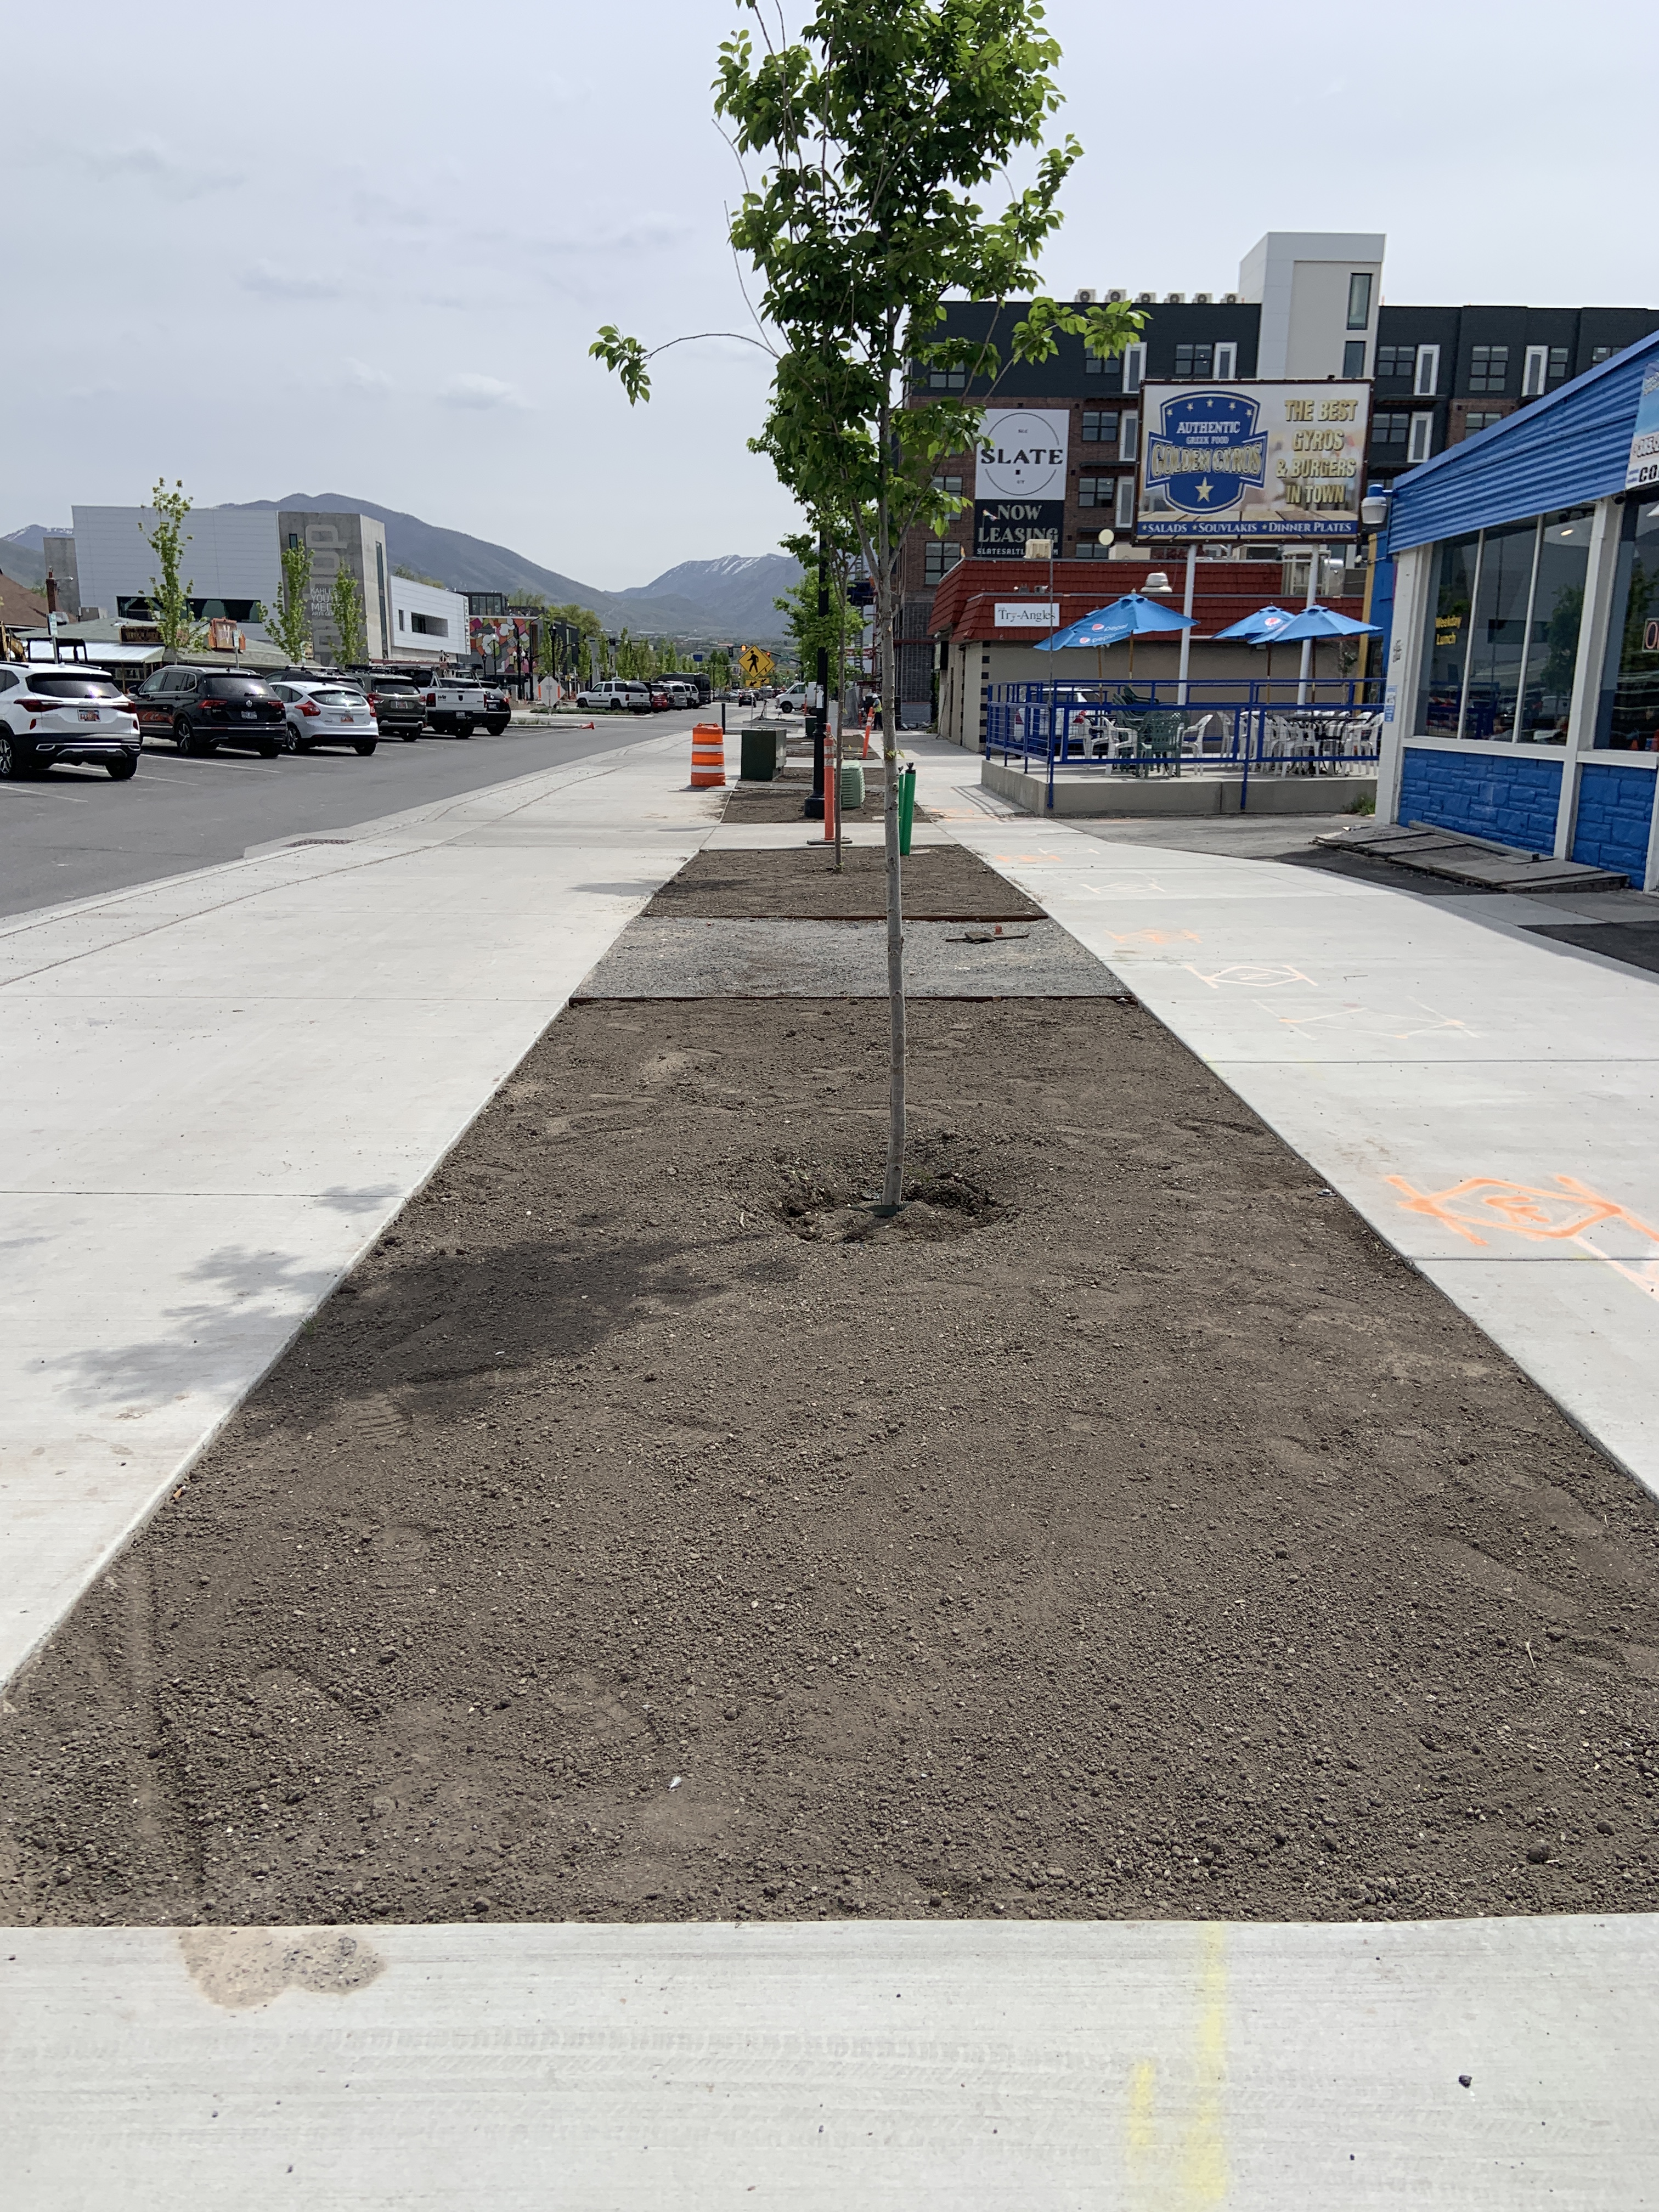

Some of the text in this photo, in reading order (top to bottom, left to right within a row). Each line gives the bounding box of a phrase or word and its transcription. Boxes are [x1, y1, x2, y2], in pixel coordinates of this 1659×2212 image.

[1284, 399, 1358, 421] THE BEST
[1176, 421, 1240, 433] AUTHENTIC
[1293, 429, 1344, 451] GYROS
[981, 448, 1063, 465] SLATE
[1151, 442, 1262, 478] GOLDEN GYROS
[1276, 458, 1357, 478] & BURGERS
[1285, 484, 1345, 504] IN TOWN
[997, 505, 1042, 521] NOW
[978, 527, 1059, 543] LEASING
[1148, 522, 1352, 533] SALADS SOUVLAKIS DINNER PLATES
[998, 610, 1056, 623] Try-Angles
